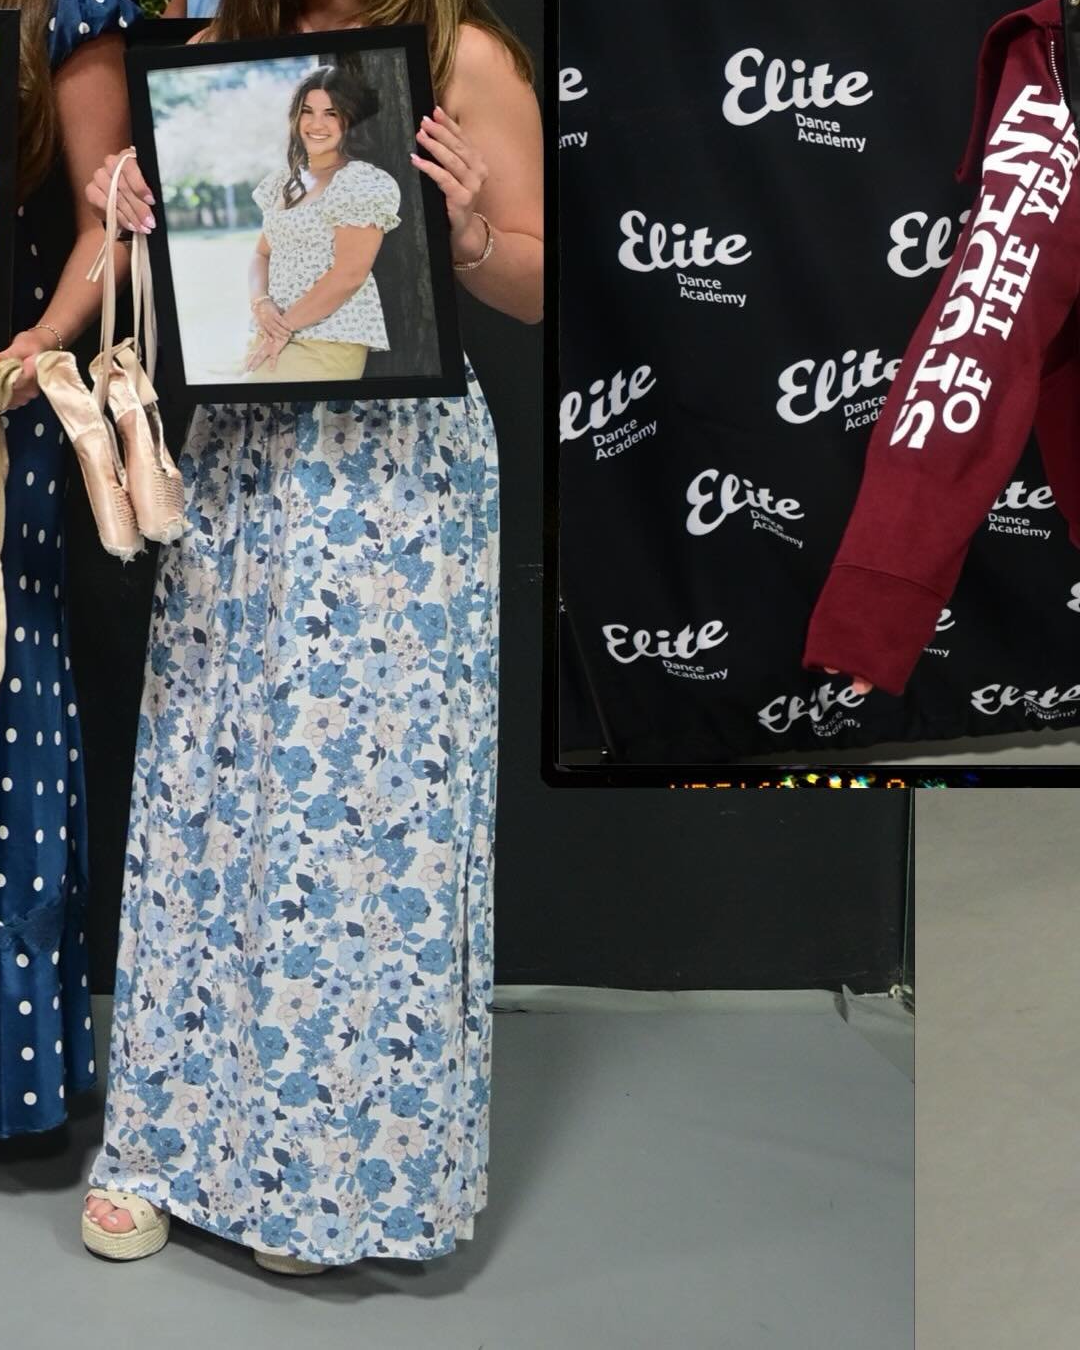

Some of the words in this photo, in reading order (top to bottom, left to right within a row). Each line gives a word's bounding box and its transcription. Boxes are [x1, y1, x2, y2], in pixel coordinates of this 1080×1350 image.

[722, 48, 874, 127] Elite
[795, 113, 841, 133] Dance
[797, 128, 867, 153] Academy
[618, 210, 752, 273] Elite
[889, 84, 1070, 450] STUDENT
[677, 273, 722, 290] Dance
[680, 287, 747, 308] Academy
[942, 355, 993, 434] OF
[973, 235, 1041, 341] THE
[559, 365, 657, 444] lite
[844, 396, 888, 418] Dance
[593, 419, 638, 448] Dance
[845, 408, 882, 432] Acad
[595, 420, 657, 461] Academy
[686, 468, 805, 536] Elite
[988, 513, 1031, 527] Dance
[988, 522, 1052, 540] Academy
[602, 620, 728, 664] Elite
[662, 660, 705, 673] Dance
